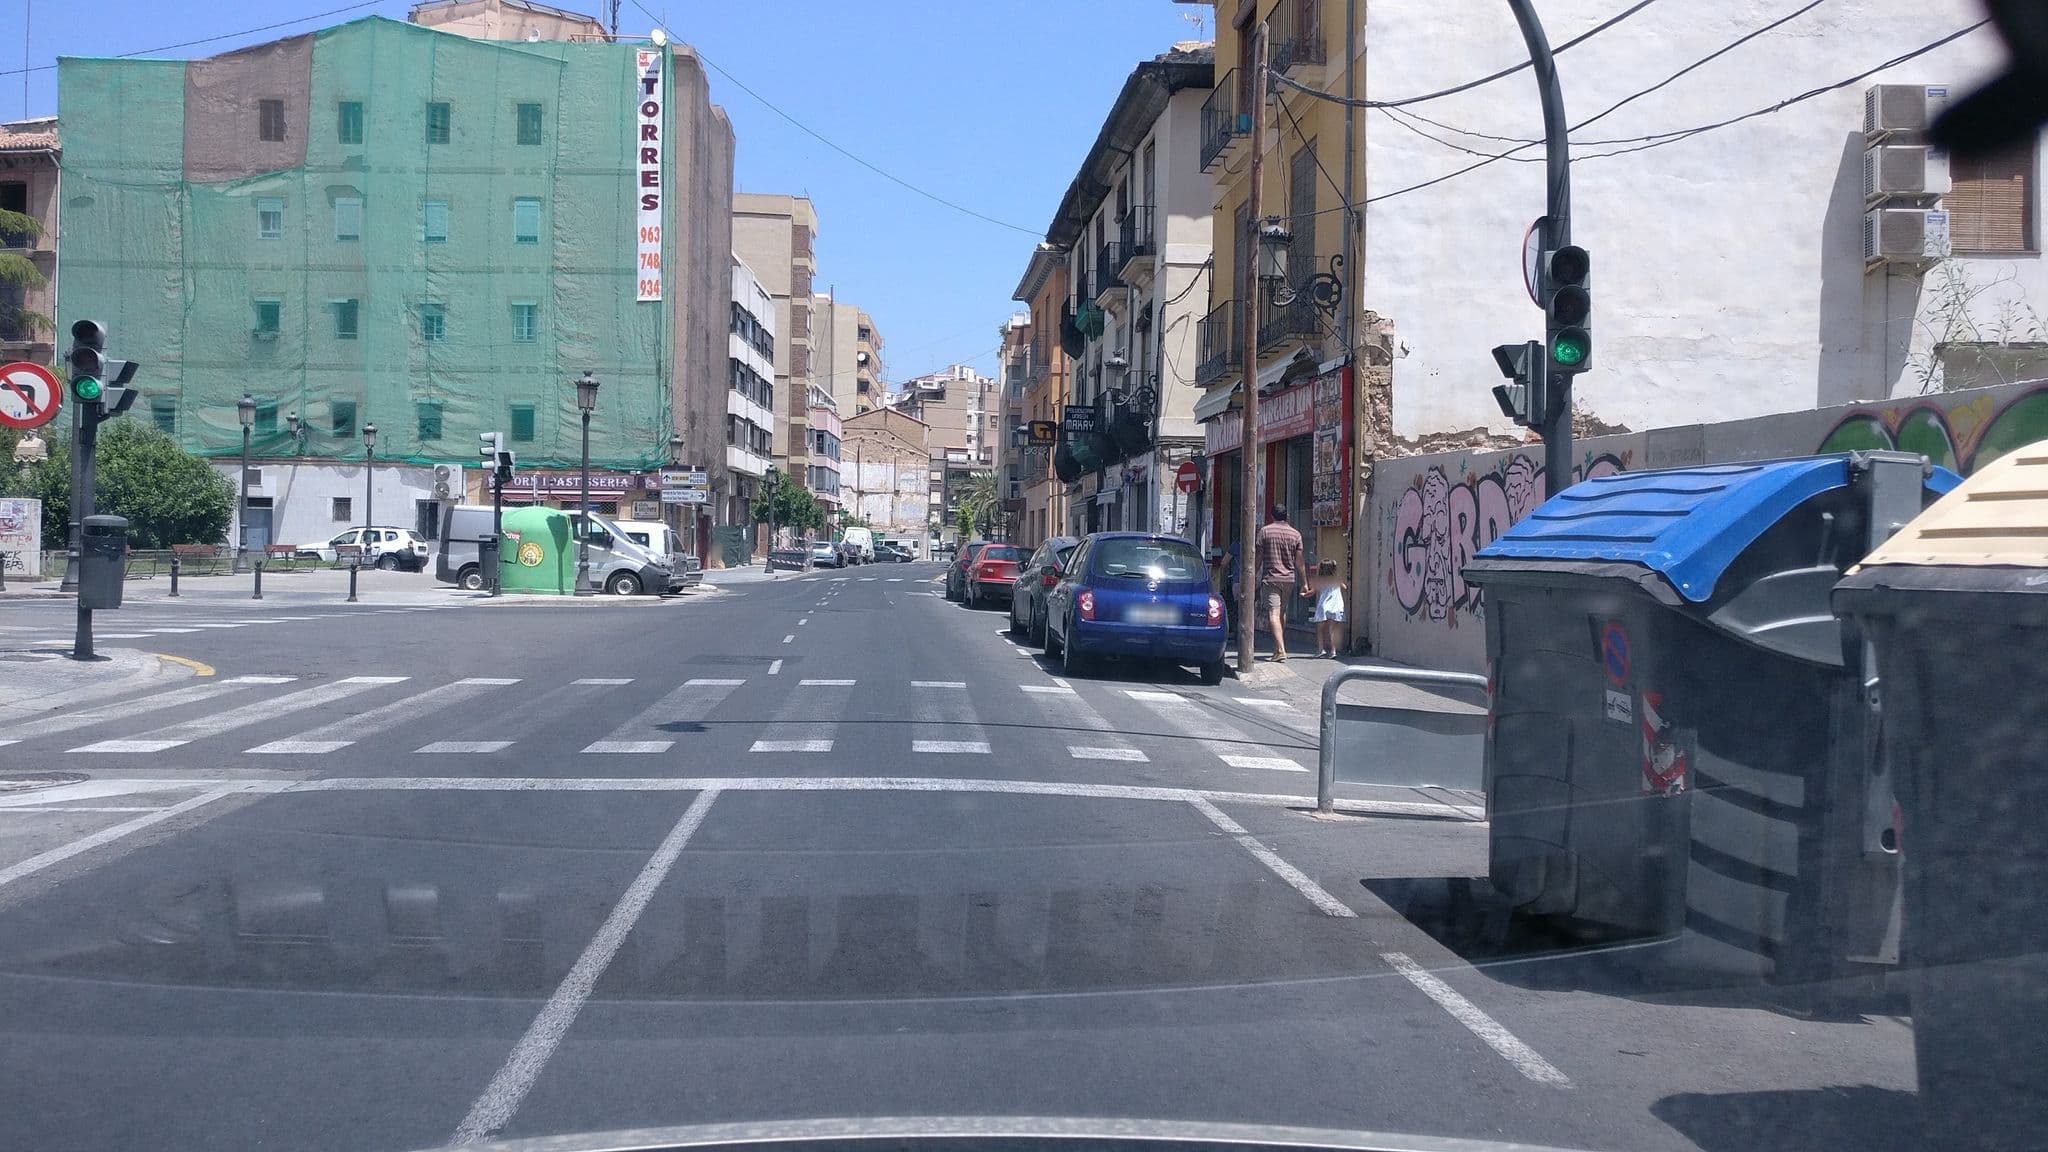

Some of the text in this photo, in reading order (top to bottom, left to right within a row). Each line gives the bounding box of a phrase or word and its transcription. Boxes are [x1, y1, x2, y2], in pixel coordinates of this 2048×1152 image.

[641, 77, 660, 211] TORRES
[640, 227, 661, 244] 963
[640, 253, 661, 270] 748
[640, 280, 661, 297] 934
[1065, 419, 1094, 431] MAKAY
[512, 478, 538, 487] ORN
[550, 478, 629, 488] PASTSSERIA
